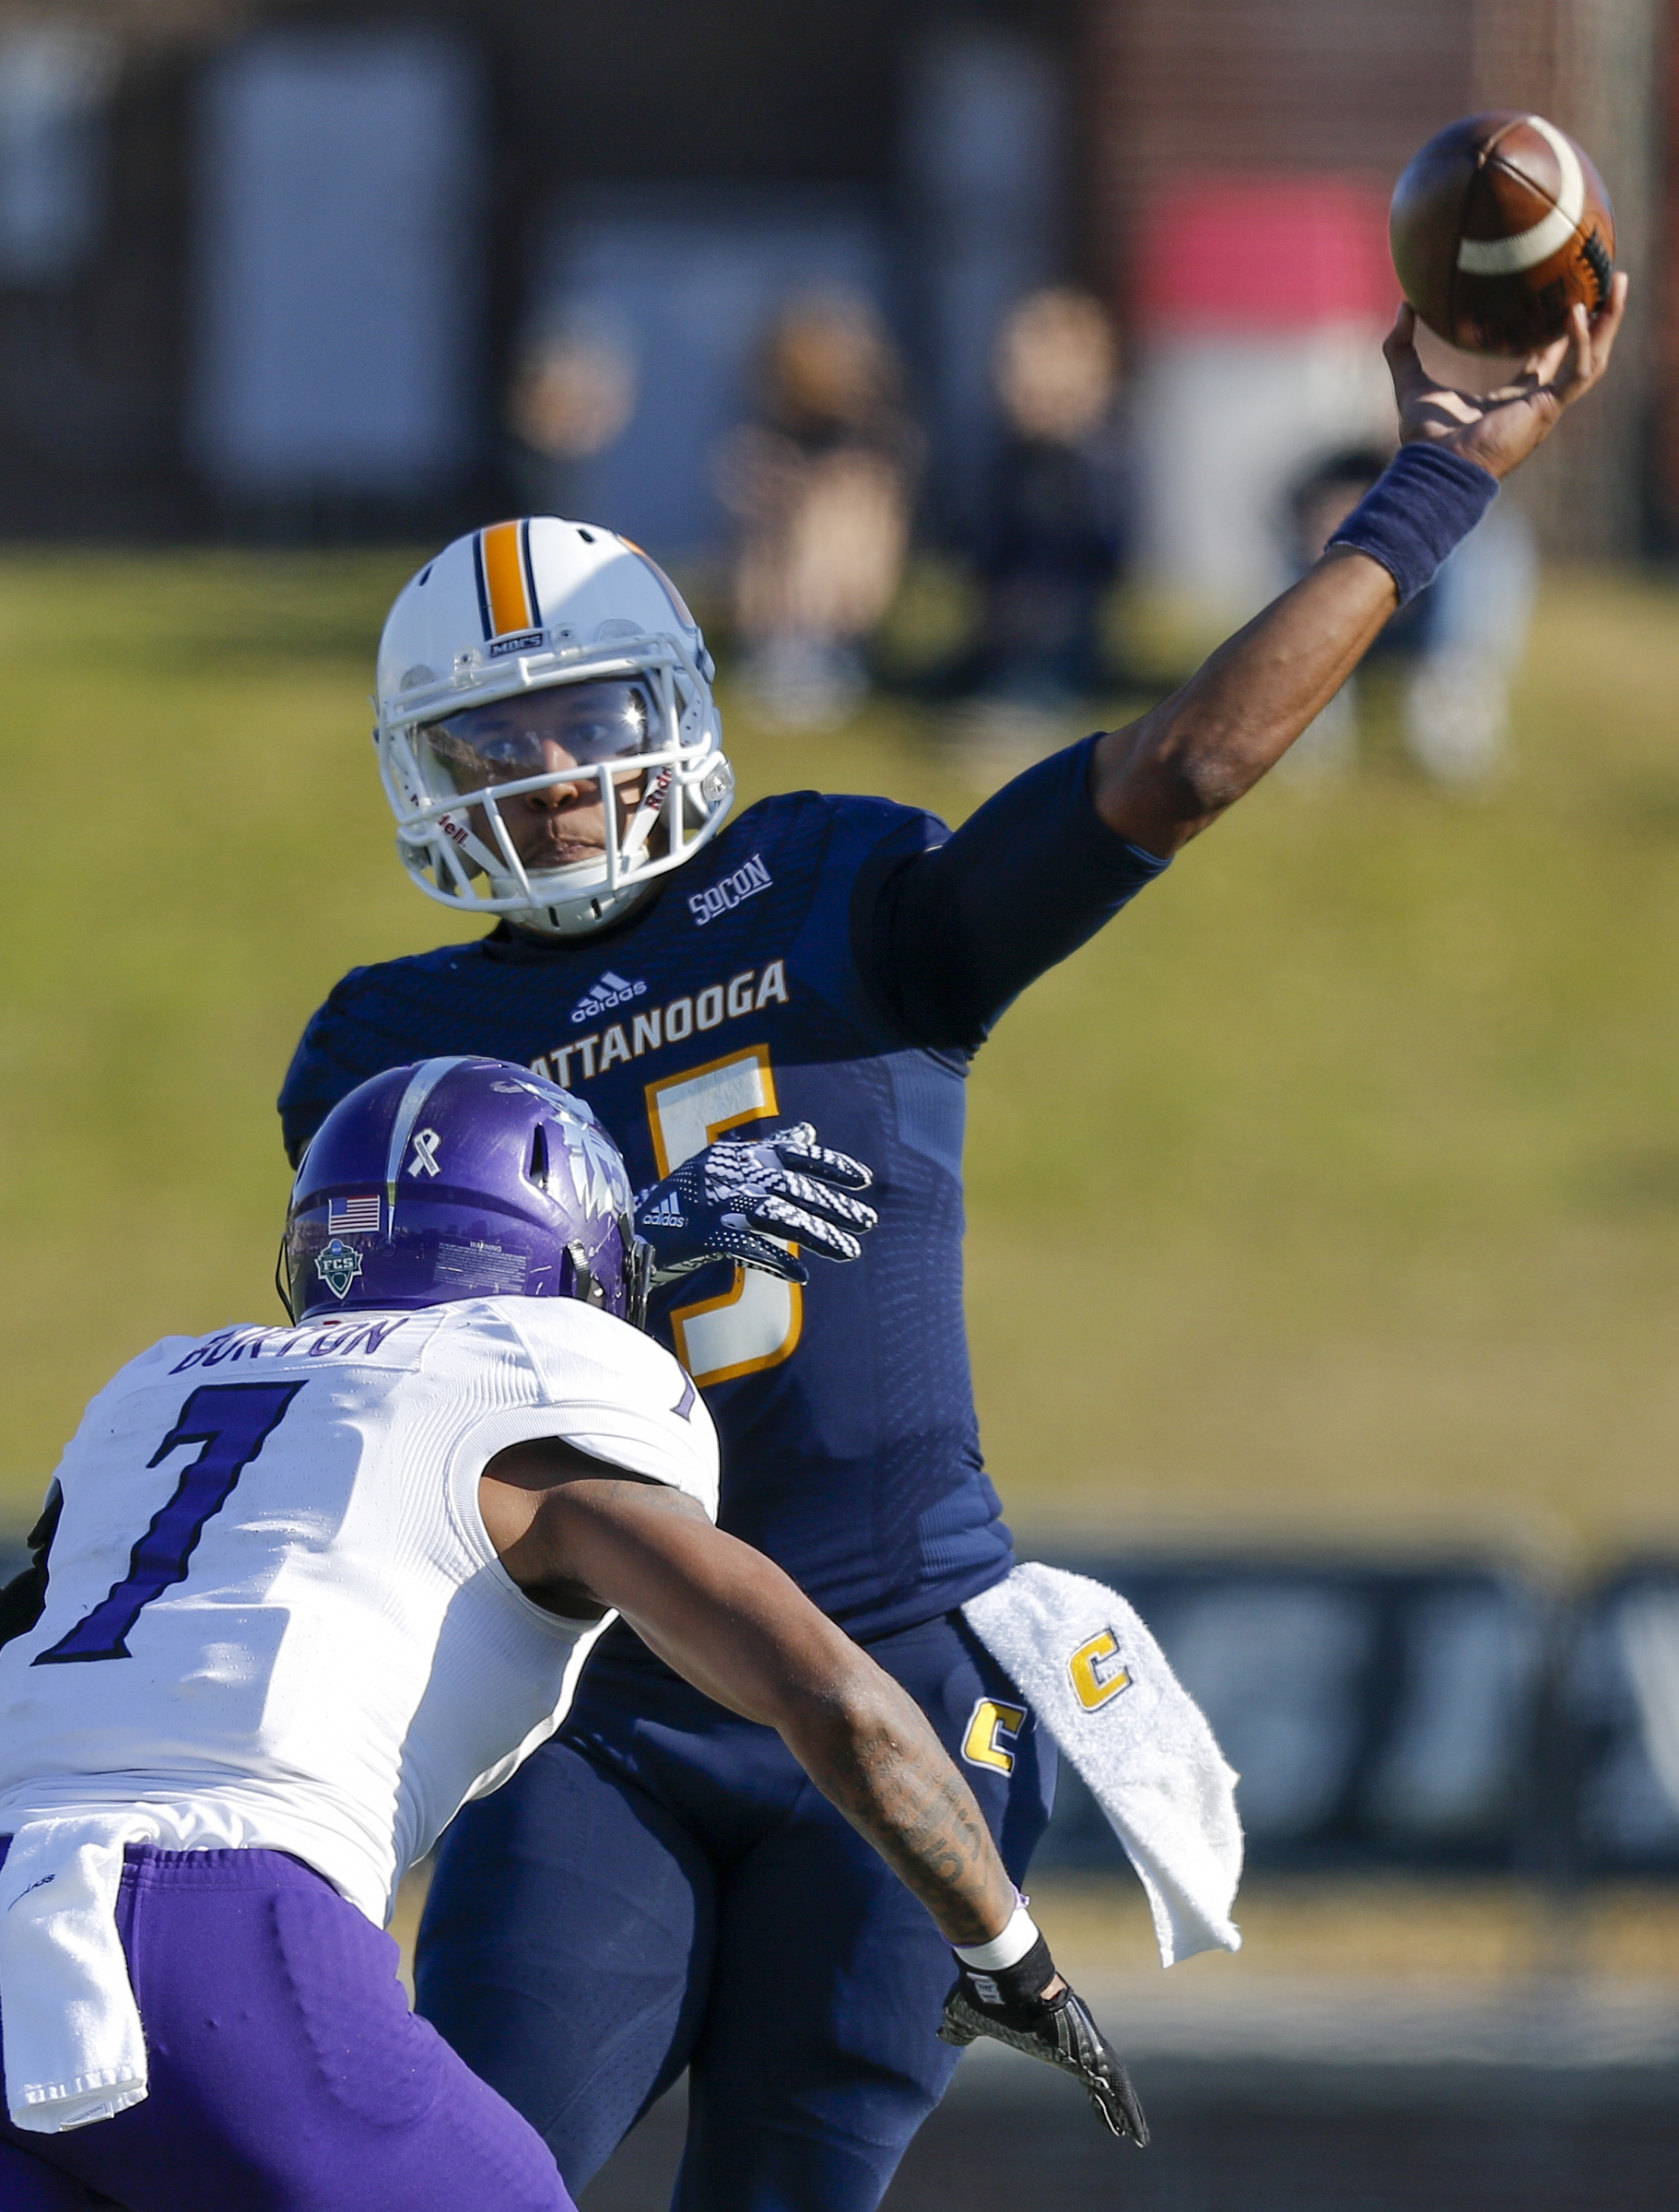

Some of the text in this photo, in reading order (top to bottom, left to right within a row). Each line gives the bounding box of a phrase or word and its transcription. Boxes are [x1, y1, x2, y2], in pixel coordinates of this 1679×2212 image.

[688, 853, 773, 926] SOCON
[570, 980, 648, 1024] adidas
[643, 1213, 686, 1229] adidas
[645, 1043, 804, 1390] 5
[323, 1257, 354, 1271] FCS
[29, 1379, 311, 1668] 7
[1067, 1627, 1133, 1714] C
[960, 1697, 1028, 1778] C
